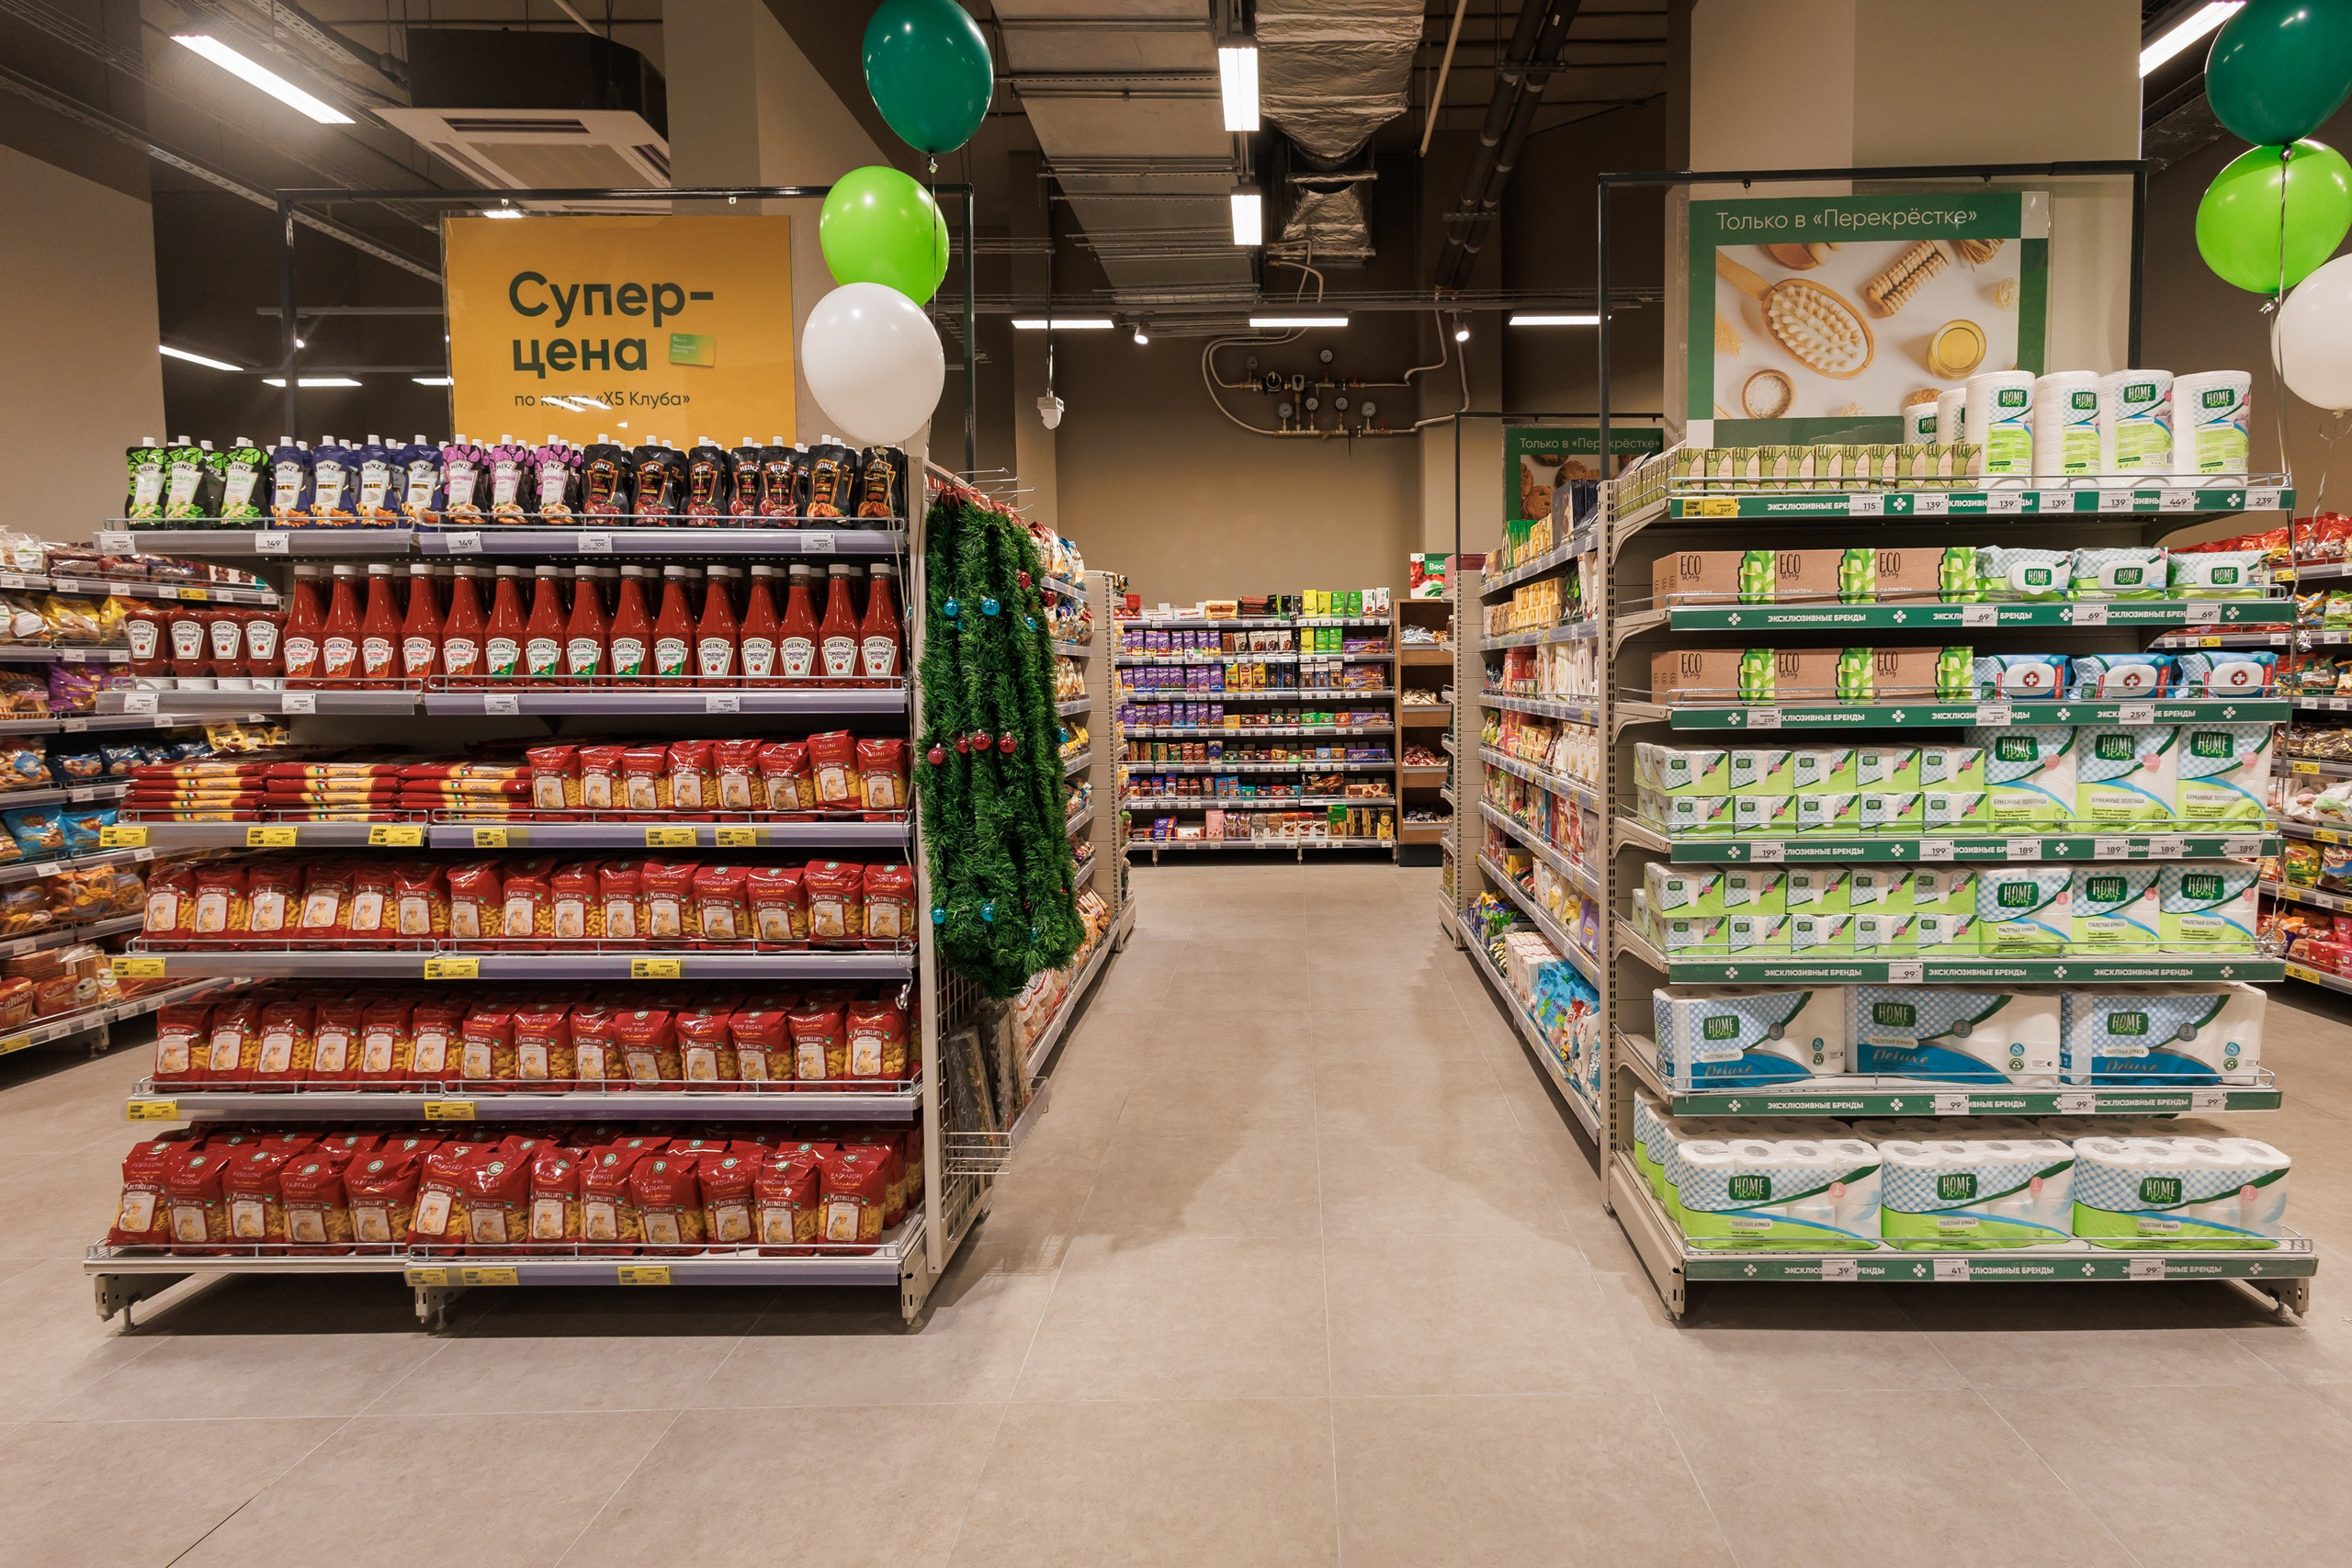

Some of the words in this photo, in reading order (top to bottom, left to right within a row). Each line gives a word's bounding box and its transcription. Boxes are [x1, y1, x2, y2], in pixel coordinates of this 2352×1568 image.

[1716, 212, 1788, 231] Только
[1795, 214, 1806, 229] в
[1813, 209, 1978, 231] «Перекрёстке»
[509, 271, 714, 328] Супер-
[513, 338, 647, 379] цена
[2002, 391, 2024, 404] HOME
[2128, 386, 2152, 400] HOME
[2206, 390, 2230, 404] HOME
[514, 395, 536, 406] по
[629, 392, 691, 409] Клуба»
[1520, 437, 1561, 449] Только
[1562, 440, 1569, 448] в
[1572, 437, 1660, 452] «Перкрёстке»
[740, 464, 758, 473] HEINZ
[817, 463, 833, 471] HEINZ
[1767, 502, 1833, 511] ЭКСКЛЮЗИВНЫЕ
[1680, 555, 1702, 576] ECO
[1780, 554, 1801, 575] ECO
[1880, 552, 1901, 573] ECO
[1682, 573, 1700, 582] story
[1781, 572, 1799, 581] story
[1881, 571, 1899, 580] story
[2028, 570, 2048, 581] HOME
[2119, 570, 2138, 581] HOME
[2214, 568, 2235, 581] HOME
[1834, 613, 1866, 621] БРЕНДЫ
[1681, 653, 1702, 674] ECO
[1779, 652, 1800, 673] ECO
[1877, 651, 1898, 671] ECO
[1683, 671, 1700, 680] story
[1780, 670, 1798, 680] story
[1879, 669, 1896, 678] story
[2002, 739, 2032, 754] HOME
[2102, 737, 2132, 754] HOME
[2198, 734, 2228, 751] HOME
[2006, 748, 2030, 761] story
[2106, 746, 2130, 761] story
[2201, 744, 2225, 758] story
[2093, 880, 2121, 896] HOME
[2188, 876, 2217, 894] HOME
[2192, 884, 2215, 900] story
[2004, 884, 2032, 902] HOME
[2007, 894, 2030, 906] story
[2097, 888, 2118, 902] story
[1830, 969, 1861, 977] БРЕНДЫ
[1879, 1005, 1909, 1021] HOME
[1709, 1019, 1734, 1033] HOME
[2112, 1015, 2142, 1030] HOME
[1832, 1102, 1864, 1110] БРЕНДЫ
[1995, 1100, 2026, 1109] БРЕНДЫ
[2157, 1098, 2188, 1106] БРЕНДЫ
[1735, 1178, 1764, 1194] HOME
[1942, 1176, 1971, 1194] HOME
[2146, 1180, 2176, 1197] HOME
[1738, 1189, 1761, 1201] story
[1946, 1188, 1968, 1199] story
[2150, 1191, 2172, 1204] story
[2021, 1267, 2054, 1275] БРЕНДЫ
[2189, 1265, 2222, 1274] БРЕНДЫ
